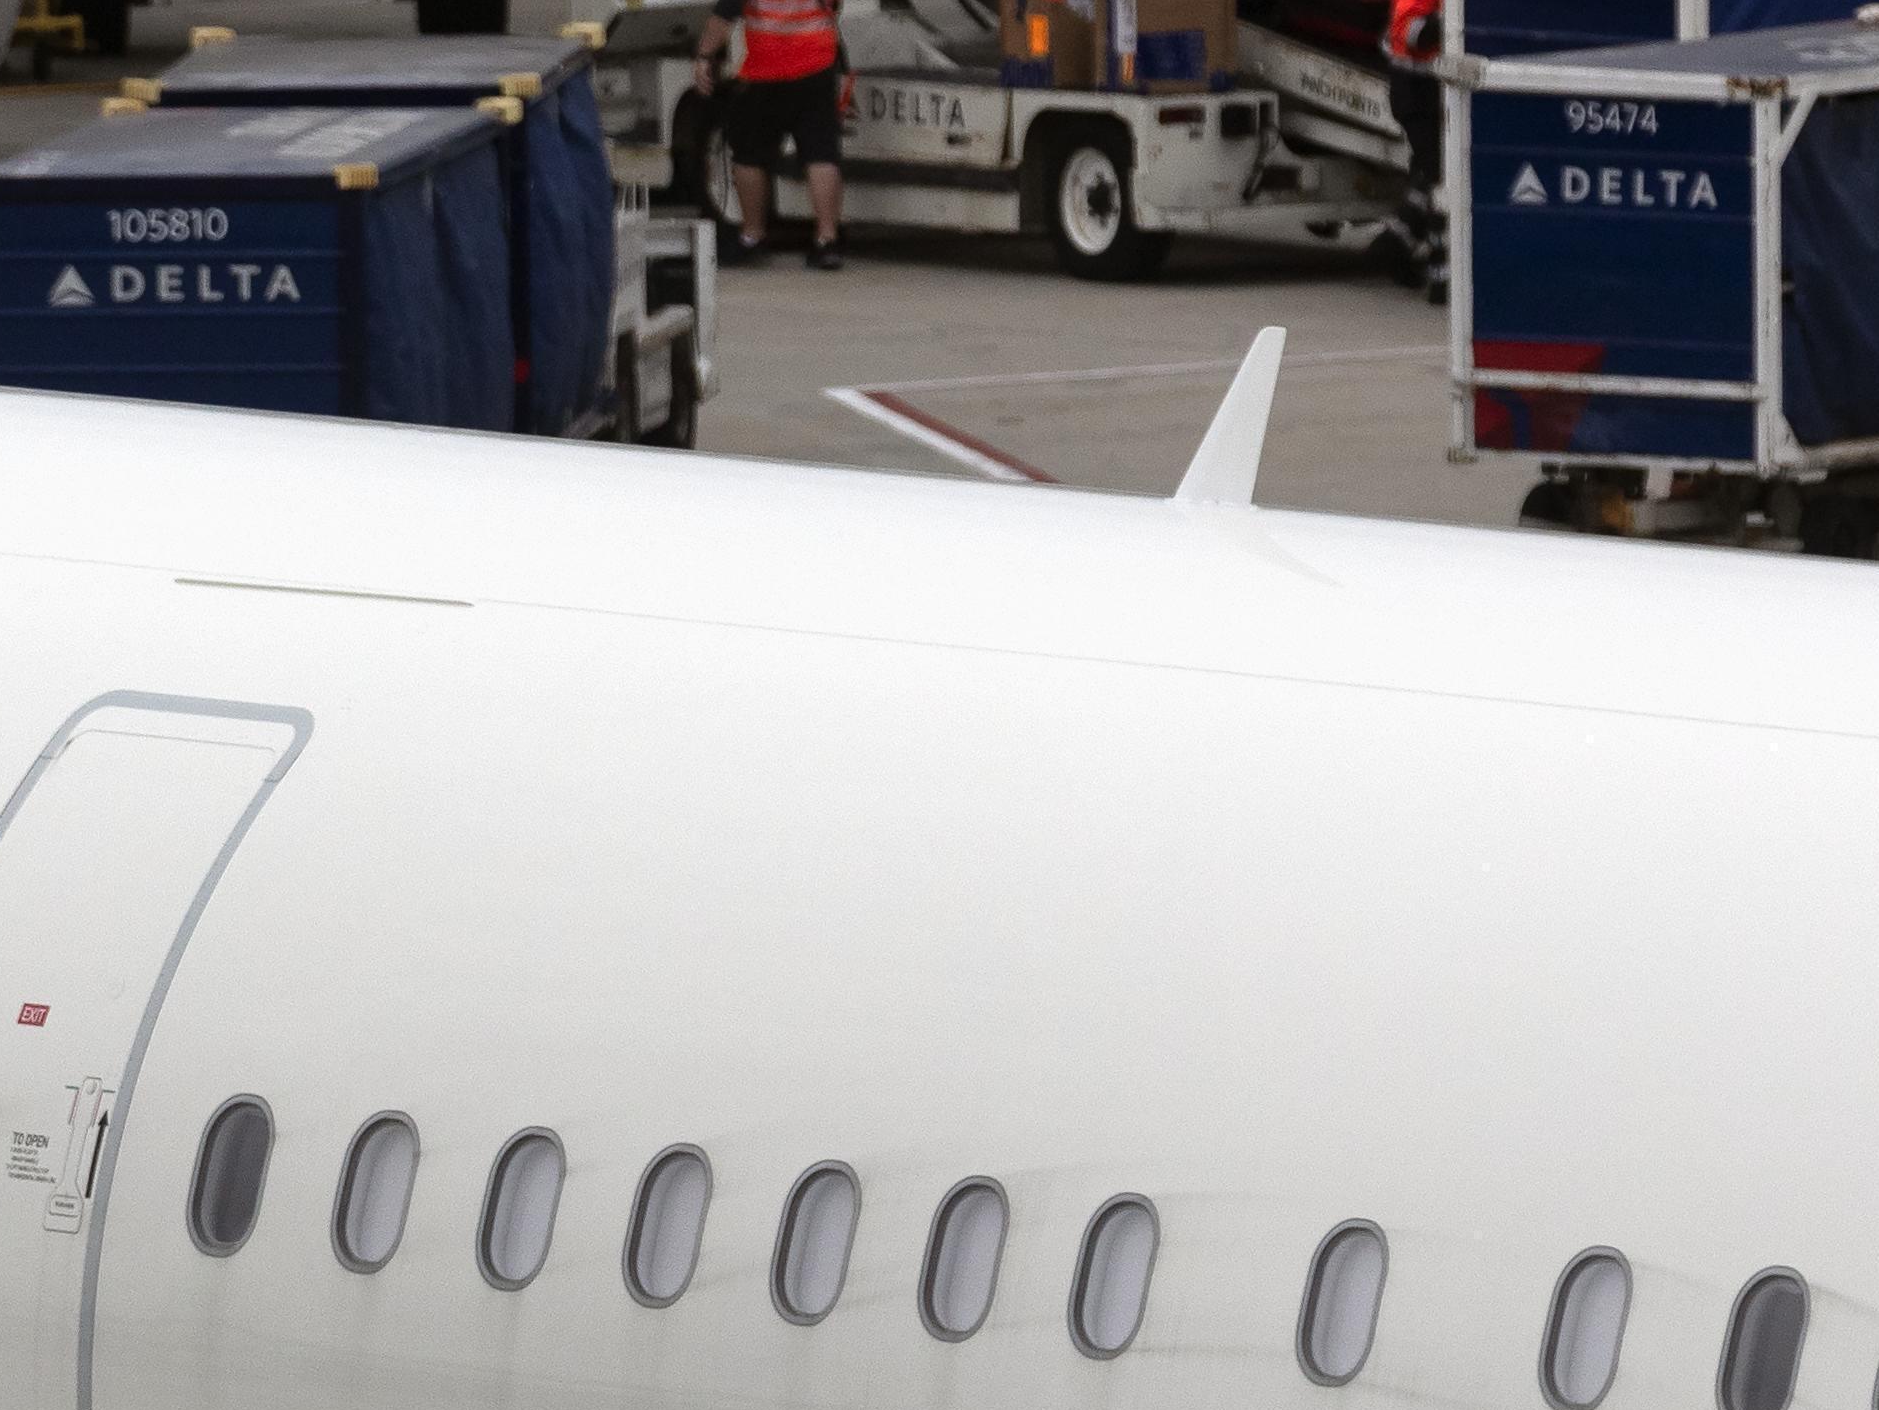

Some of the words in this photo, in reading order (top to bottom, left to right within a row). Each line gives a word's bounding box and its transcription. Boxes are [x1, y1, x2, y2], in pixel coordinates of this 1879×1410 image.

[871, 86, 967, 127] DELTA
[1565, 99, 1659, 135] 95474
[1559, 164, 1719, 209] DELTA
[107, 206, 231, 244] 105810
[109, 264, 302, 303] DELTA
[21, 1005, 47, 1024] EXIT
[12, 1131, 25, 1146] TO
[25, 1134, 50, 1149] OPEN
